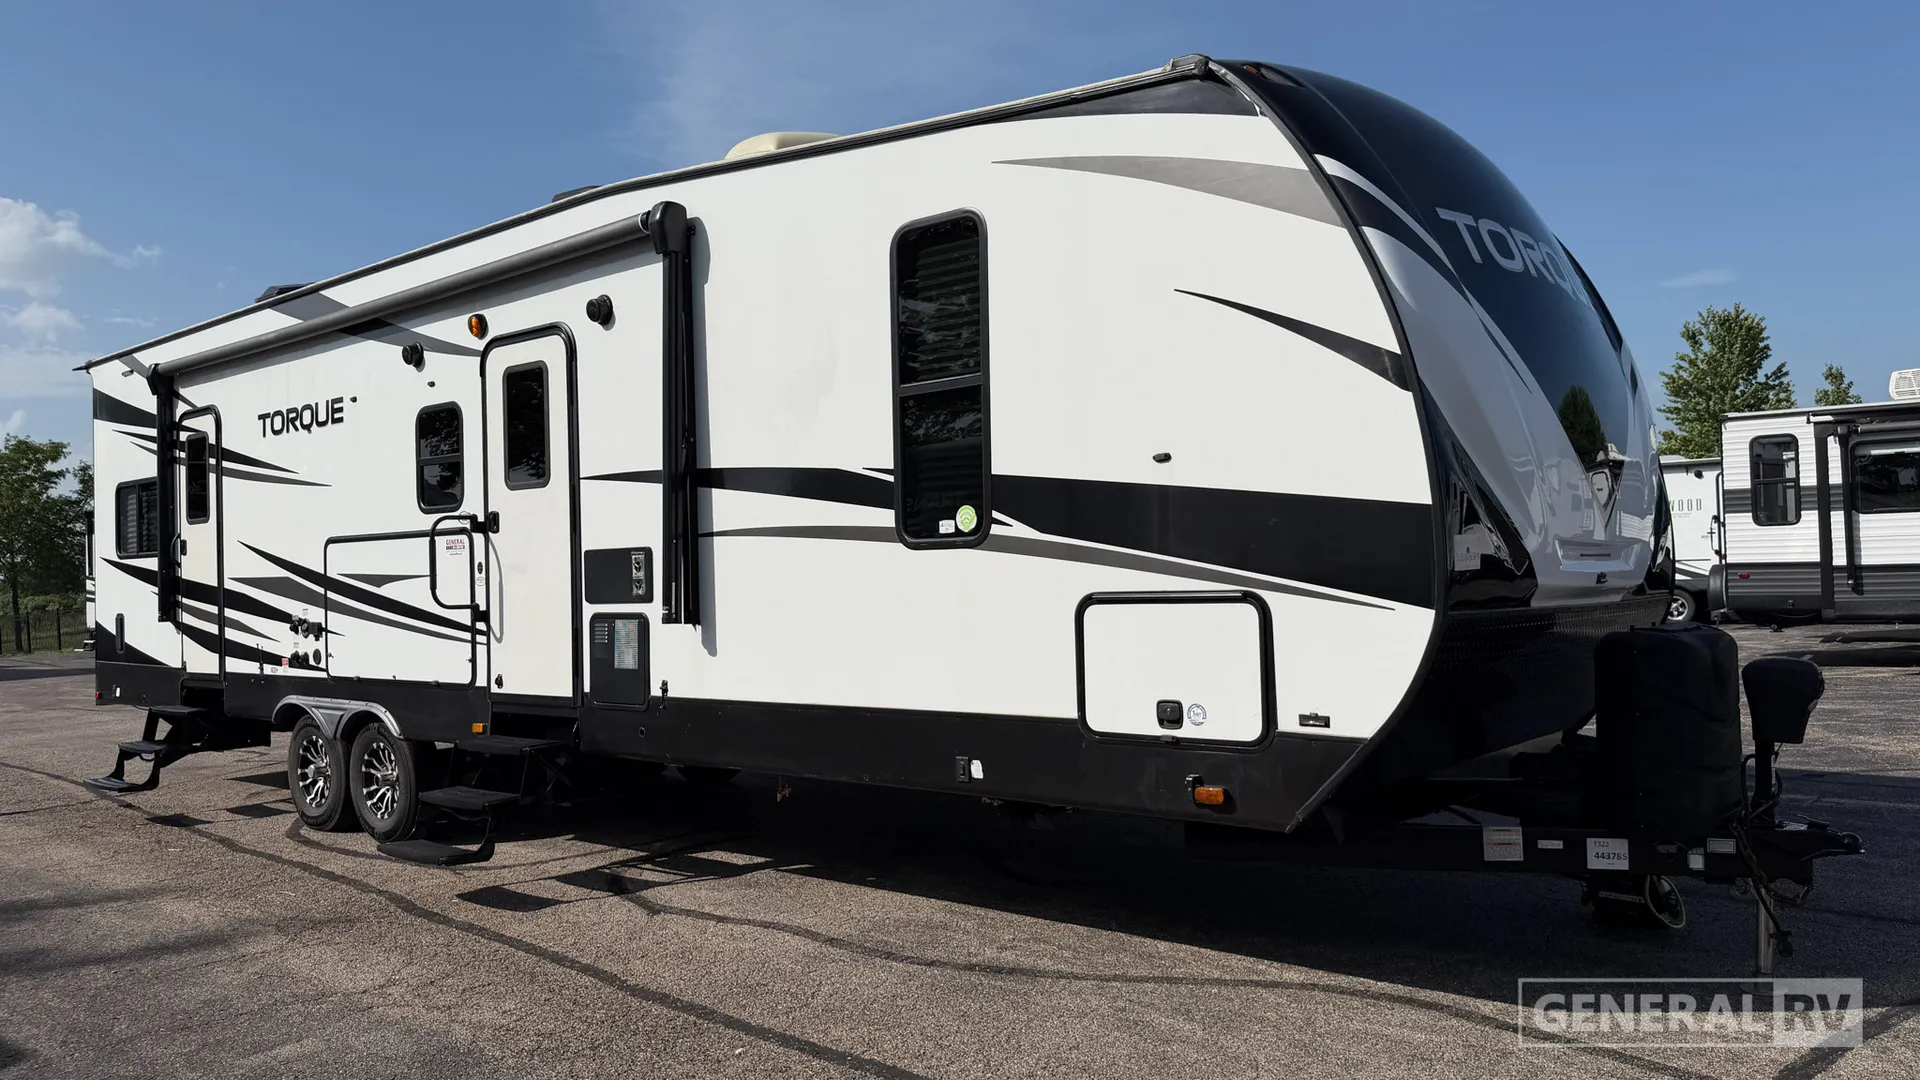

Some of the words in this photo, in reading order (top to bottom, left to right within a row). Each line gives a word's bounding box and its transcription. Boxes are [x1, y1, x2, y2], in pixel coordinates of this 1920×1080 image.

[1435, 206, 1592, 308] TORQ
[257, 396, 344, 438] TORQUE
[1594, 851, 1628, 861] 443785
